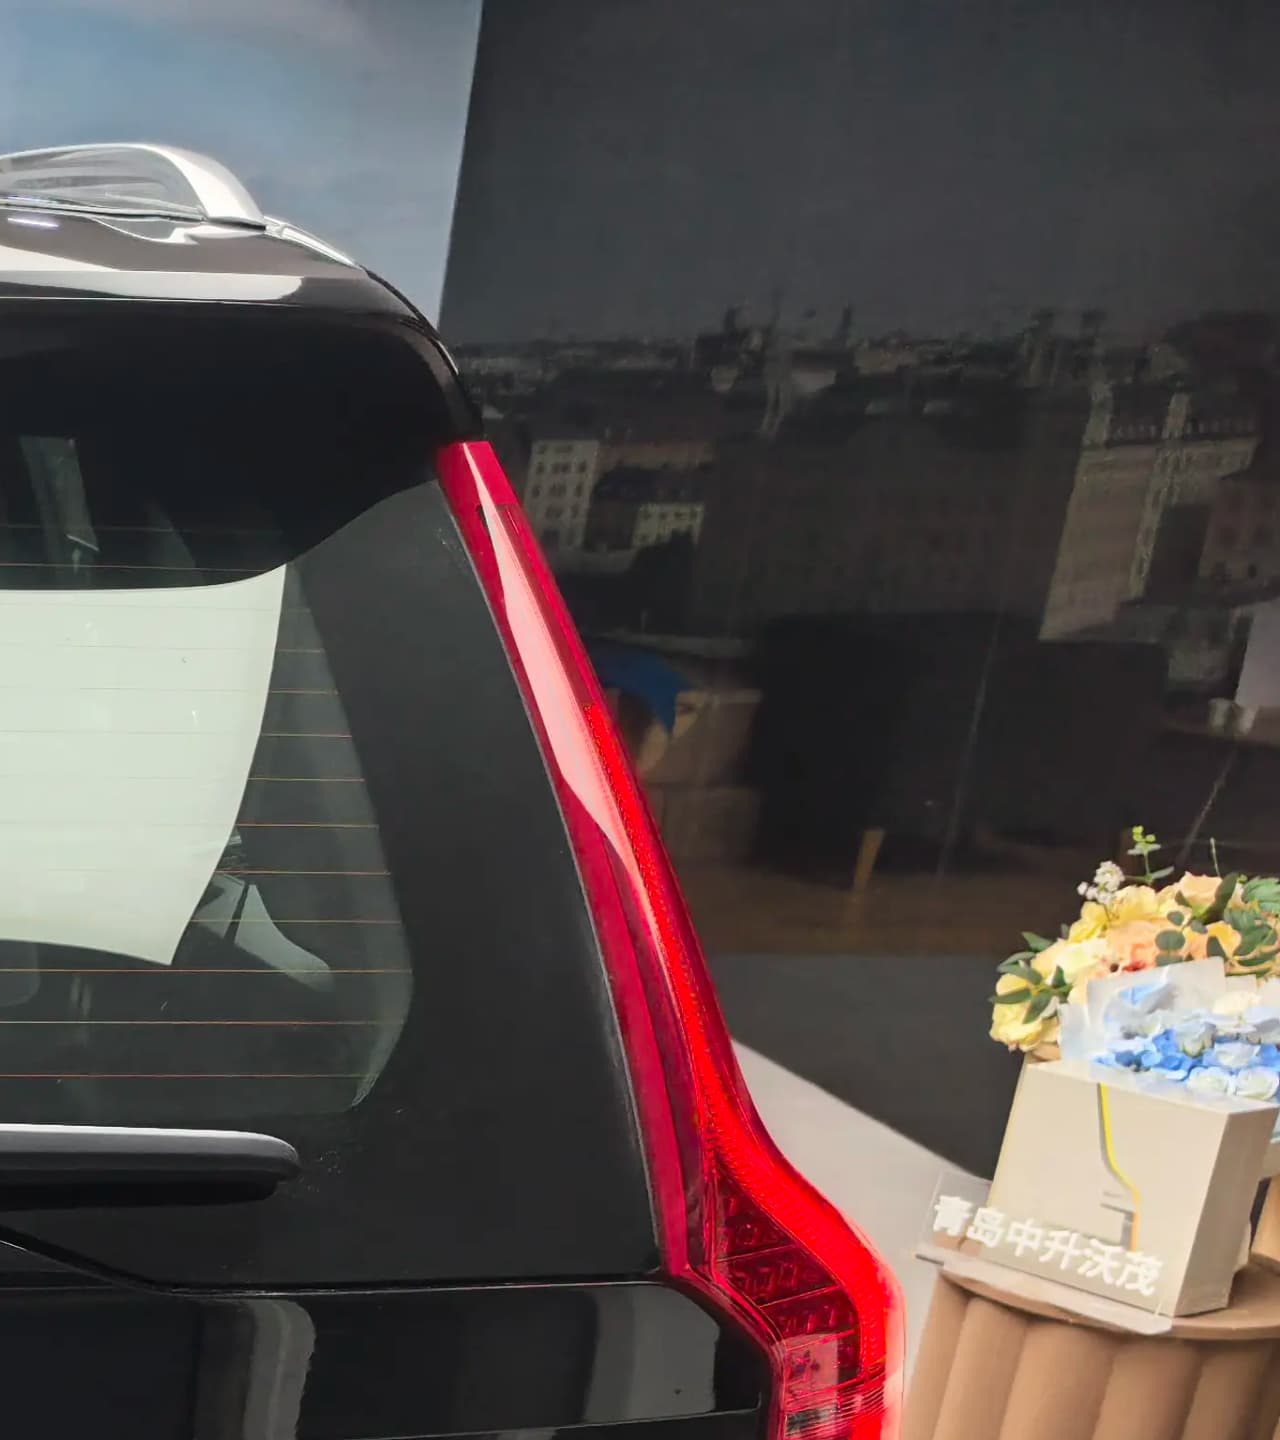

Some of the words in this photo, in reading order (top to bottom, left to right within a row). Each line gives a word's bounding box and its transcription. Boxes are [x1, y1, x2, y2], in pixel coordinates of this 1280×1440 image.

[933, 1195, 1163, 1297] 青岛中升沃茂
